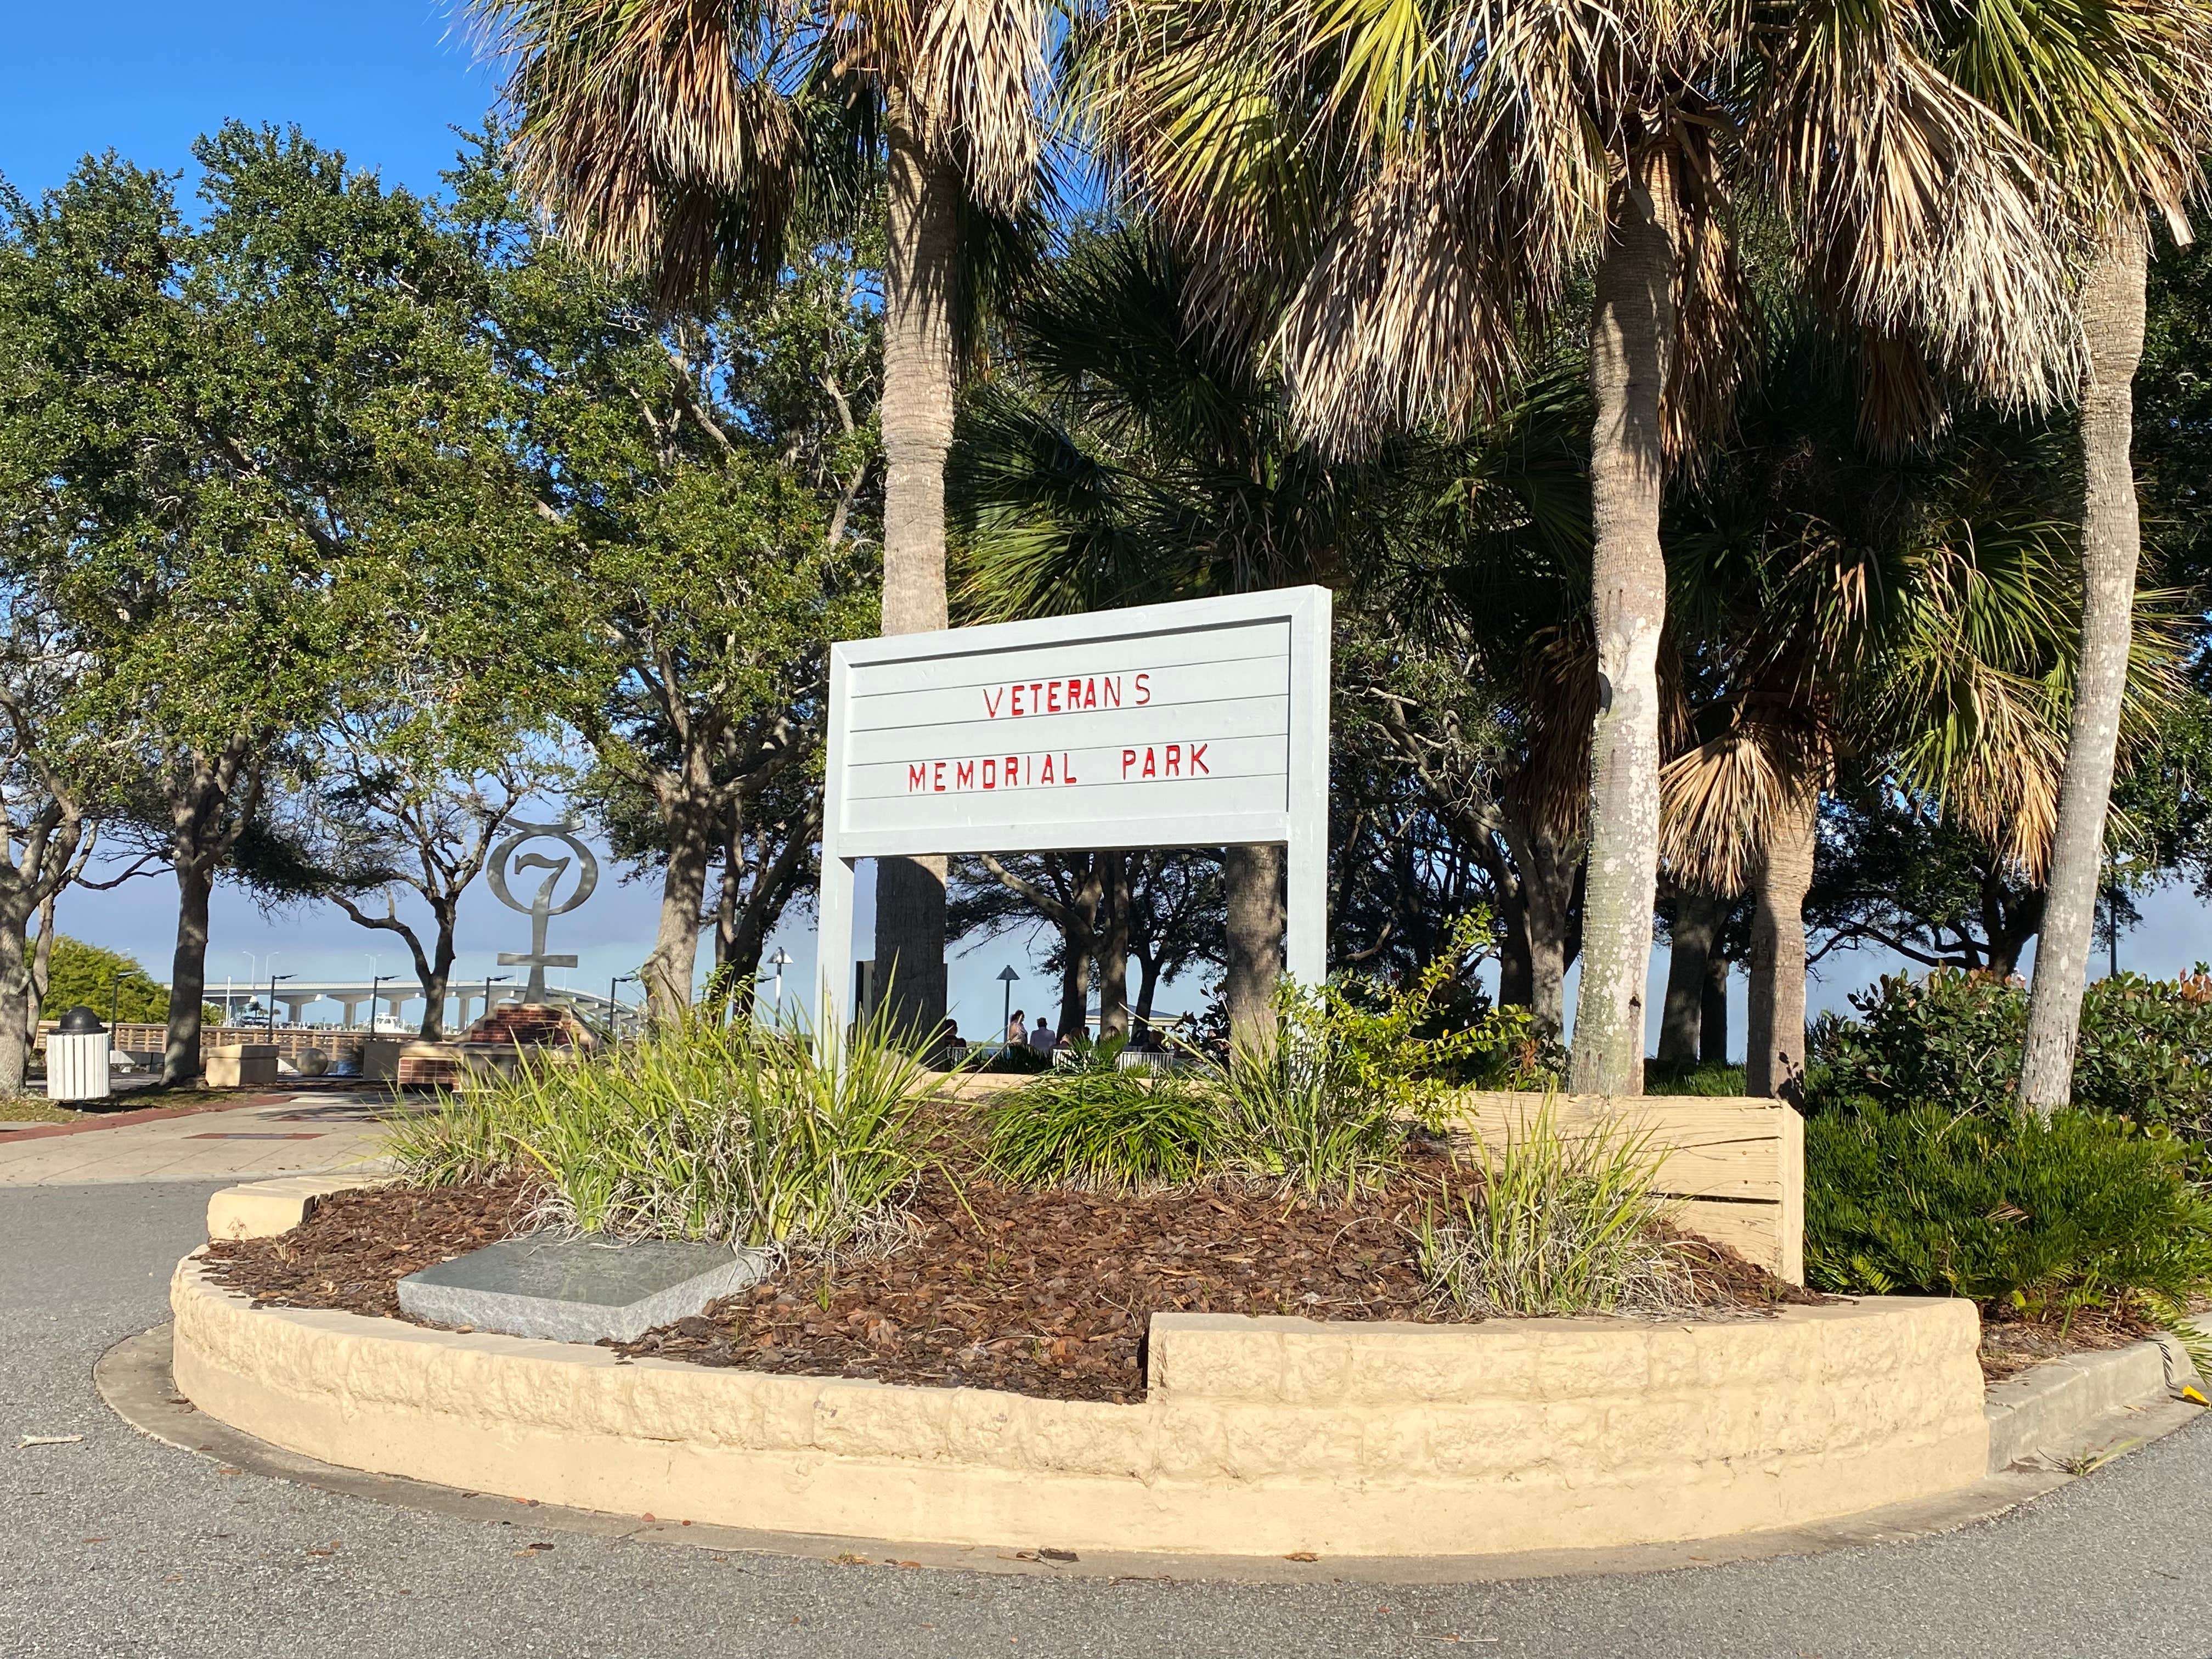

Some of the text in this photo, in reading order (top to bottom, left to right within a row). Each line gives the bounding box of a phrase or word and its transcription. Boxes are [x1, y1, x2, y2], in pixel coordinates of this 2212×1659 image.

[983, 674, 1151, 718] VETERANS
[909, 743, 1210, 792] MEMORIAL PARK
